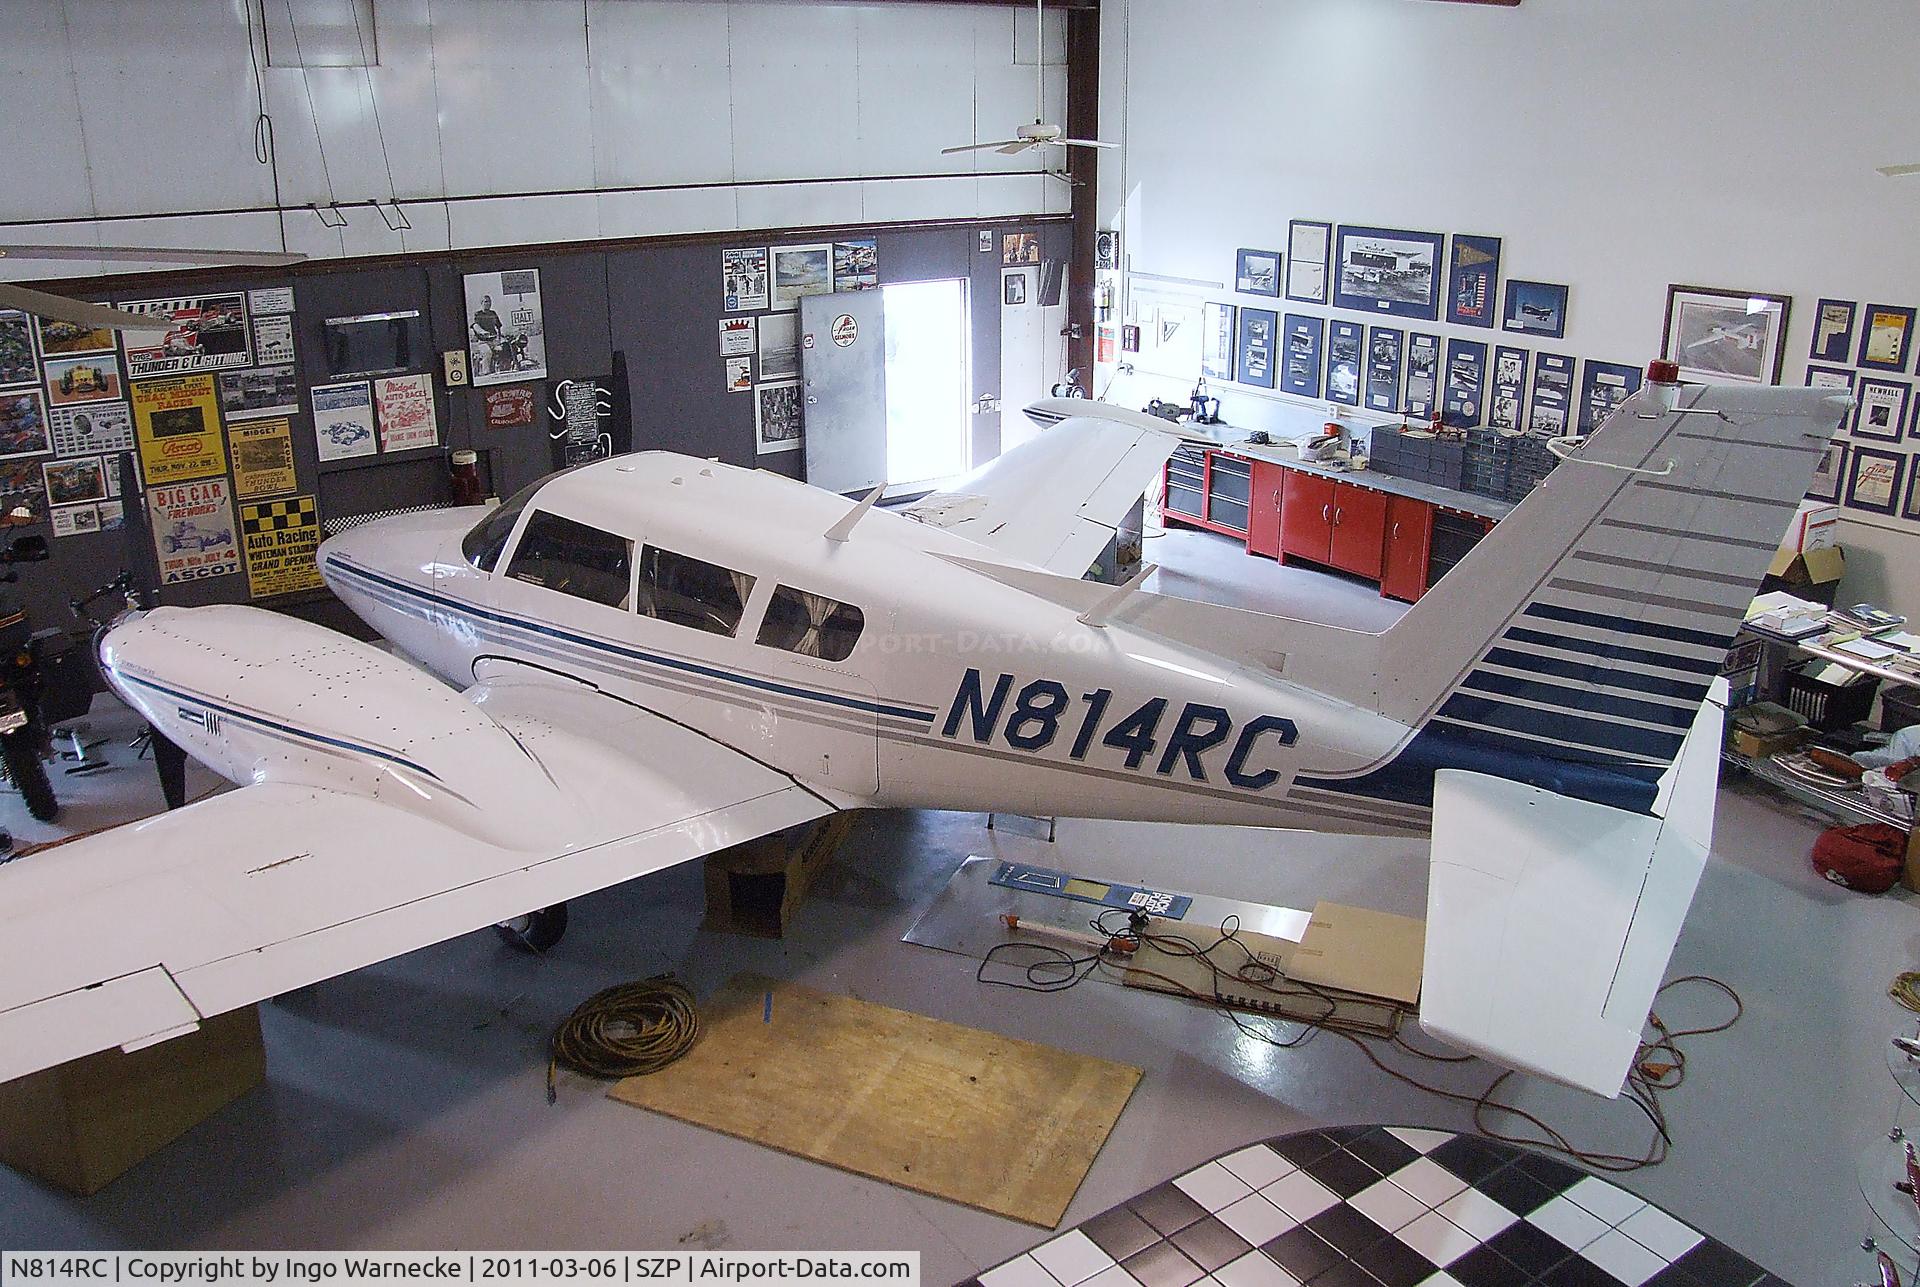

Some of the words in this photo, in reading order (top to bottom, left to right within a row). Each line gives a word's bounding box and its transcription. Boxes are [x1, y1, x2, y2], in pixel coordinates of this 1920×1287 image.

[513, 312, 532, 324] HALT
[131, 360, 178, 374] THUNDER
[192, 352, 247, 369] LIGHTNING
[385, 380, 417, 393] Midget
[385, 393, 403, 401] AUTO
[405, 390, 427, 398] RACES
[243, 428, 276, 436] MIDGET
[232, 442, 240, 469] AUTO
[283, 436, 292, 469] RACES
[245, 476, 287, 487] THUNDER
[157, 489, 186, 506] BIG
[190, 484, 222, 501] CAR
[168, 504, 217, 519] FIREWORKS
[248, 534, 273, 549] Auto
[276, 529, 317, 545] Racing
[224, 549, 237, 558] 4
[249, 547, 287, 561] WHITEMAN
[252, 560, 279, 571] GRAND
[285, 554, 317, 566] OPENIN
[167, 562, 237, 582] ASCOT
[941, 668, 1299, 791] N814RC
[1152, 892, 1175, 914] KICK
